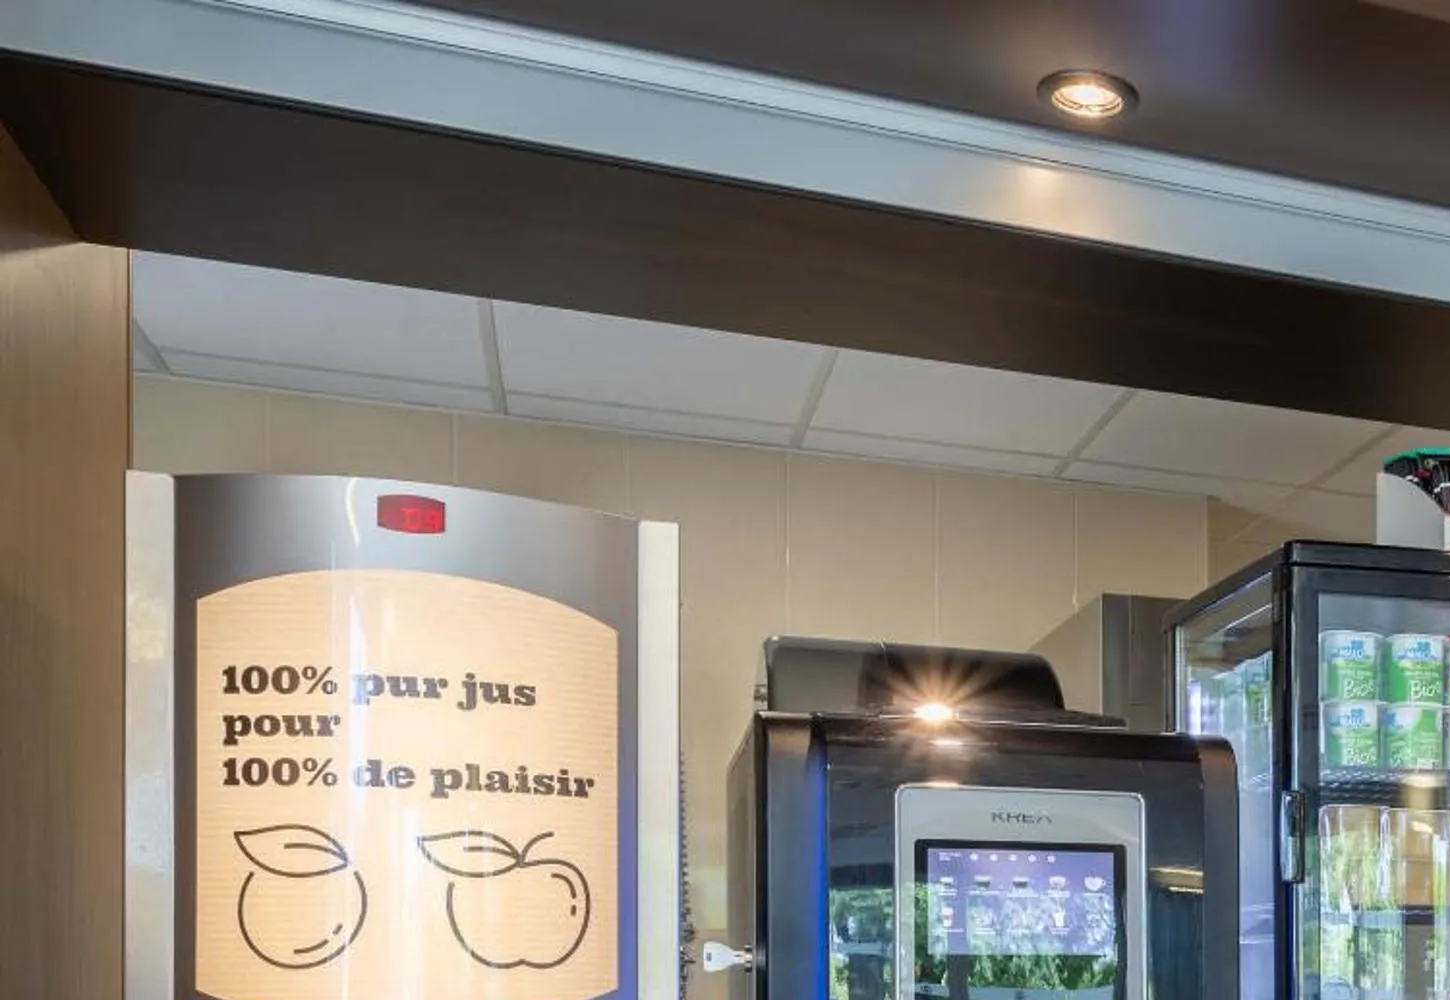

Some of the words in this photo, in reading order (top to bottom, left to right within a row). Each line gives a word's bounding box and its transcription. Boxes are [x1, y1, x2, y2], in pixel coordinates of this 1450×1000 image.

[221, 664, 338, 695] 100%
[351, 671, 449, 706] pur
[456, 672, 537, 710] jus
[222, 713, 341, 746] pour
[221, 756, 338, 787] 100%
[351, 759, 416, 789] de
[430, 763, 596, 799] plaisir
